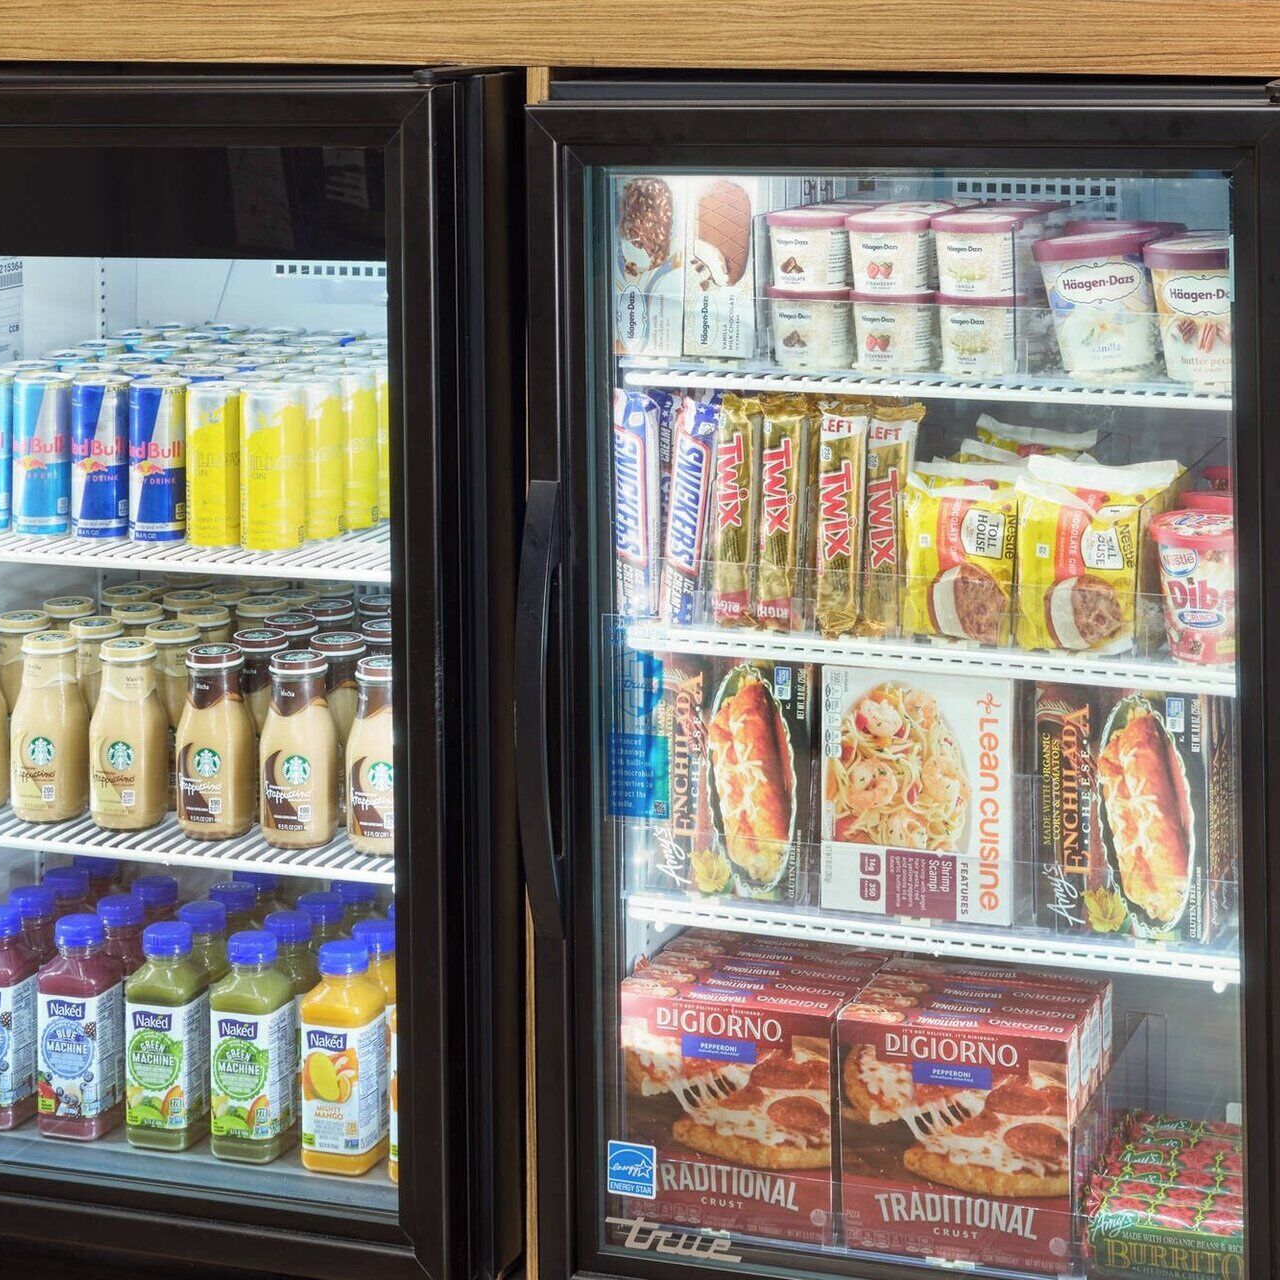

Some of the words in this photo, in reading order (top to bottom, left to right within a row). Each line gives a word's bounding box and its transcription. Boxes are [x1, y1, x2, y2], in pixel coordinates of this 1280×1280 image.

[1063, 274, 1135, 291] Häagen-Dazs
[1181, 356, 1208, 365] butter
[718, 434, 744, 529] TWIX
[763, 438, 792, 536] TWIX
[671, 436, 703, 569] SNICKERS
[820, 461, 852, 560] TWIX
[869, 469, 899, 569] TWIX
[976, 514, 988, 553] HOUSE
[988, 522, 999, 552] TOLL
[1063, 704, 1091, 878] ENCHILADA
[654, 823, 691, 886] Amy's
[929, 859, 939, 893] Scampi
[941, 861, 952, 893] Shrimp
[960, 862, 969, 916] FEATURES
[1043, 862, 1085, 927] Amy's
[50, 1004, 83, 1017] Naked
[136, 1015, 169, 1029] Naked
[221, 1022, 255, 1037] Naked
[46, 1042, 88, 1054] MACHINE
[141, 1042, 165, 1052] GREEN
[310, 1033, 344, 1048] Naked
[700, 1043, 738, 1053] PEPPERONI
[133, 1053, 174, 1066] MACHINE
[226, 1051, 251, 1061] GREEN
[220, 1062, 260, 1075] MACHINE
[932, 1068, 972, 1078] PEPPERONI
[314, 1112, 343, 1120] MANGO
[610, 1182, 632, 1194] ENERGY
[634, 1184, 652, 1195] STAR
[656, 1161, 800, 1212] TRADITIONAL
[700, 1196, 744, 1209] CRUST
[874, 1192, 1038, 1241] TRADITIONAL
[933, 1227, 979, 1240] CRUST
[1105, 1238, 1244, 1280] BURRITO
